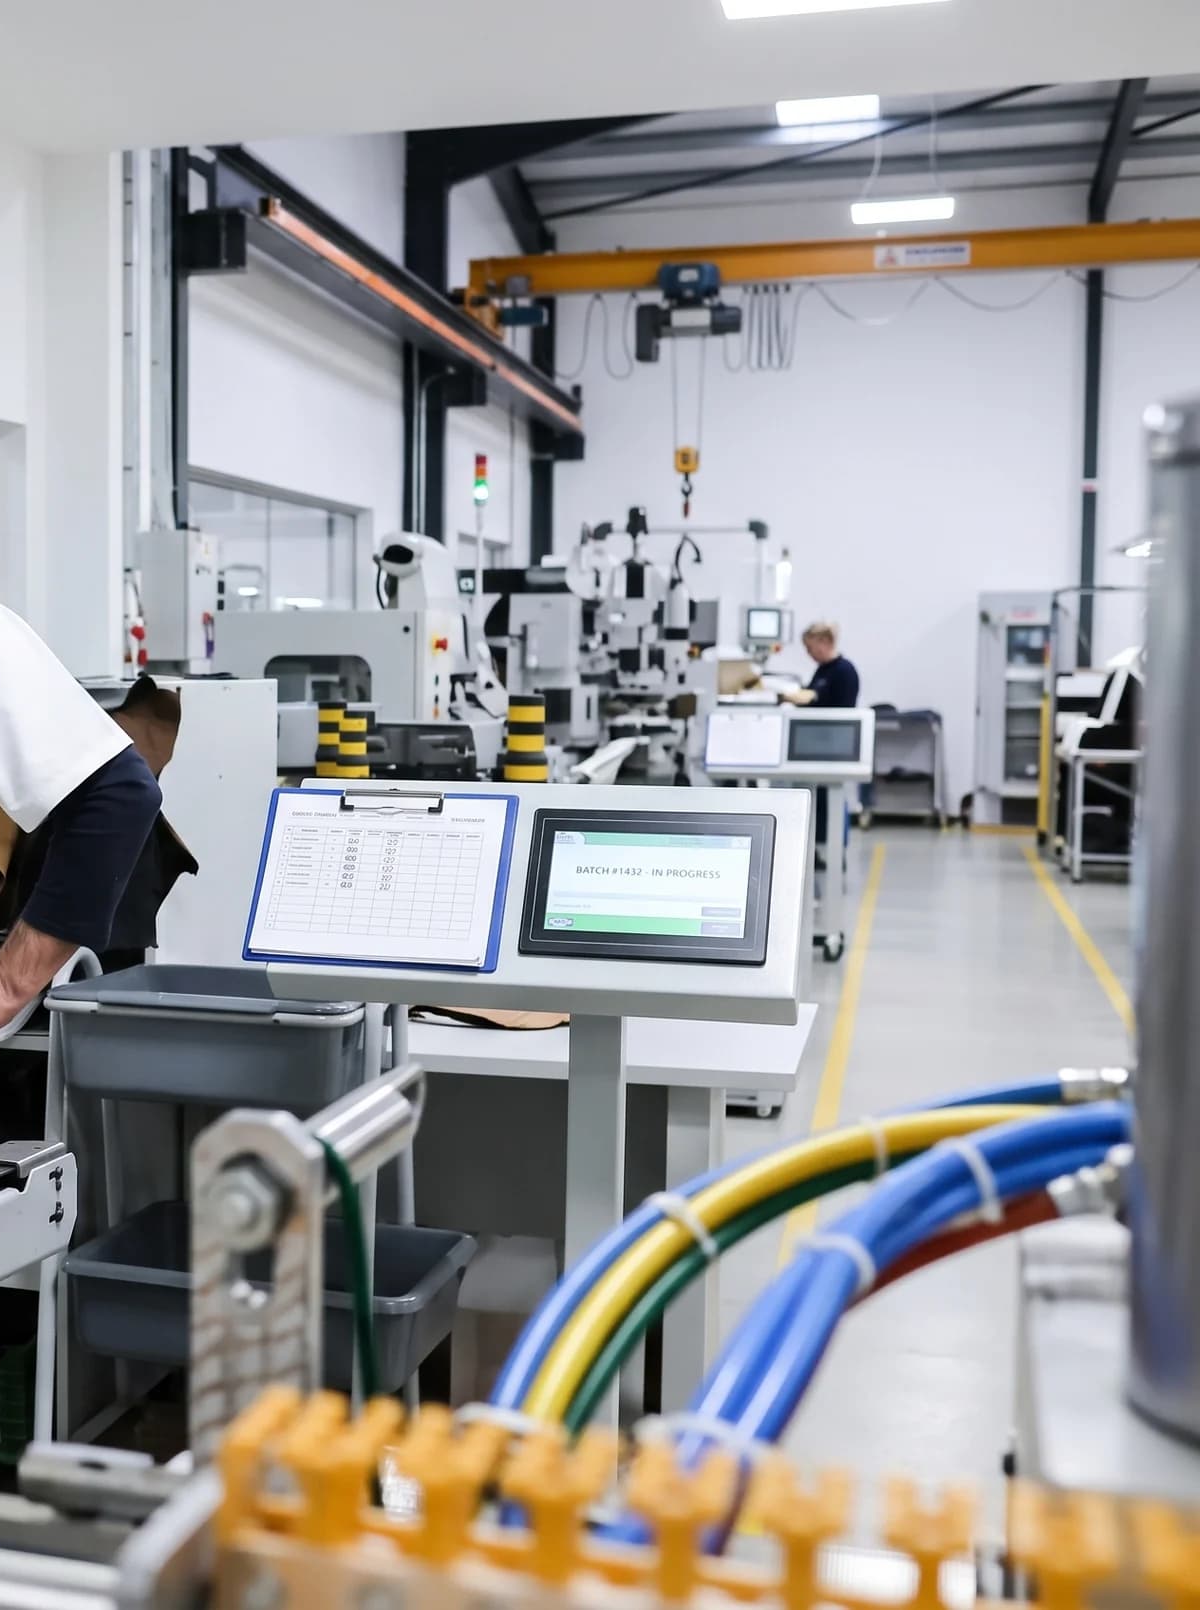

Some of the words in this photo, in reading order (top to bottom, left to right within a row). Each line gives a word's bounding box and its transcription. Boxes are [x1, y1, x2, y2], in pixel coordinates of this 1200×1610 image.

[576, 865, 610, 875] BATCH
[612, 867, 642, 876] #1432
[651, 868, 663, 877] IN
[666, 868, 721, 879] PROGRESS
